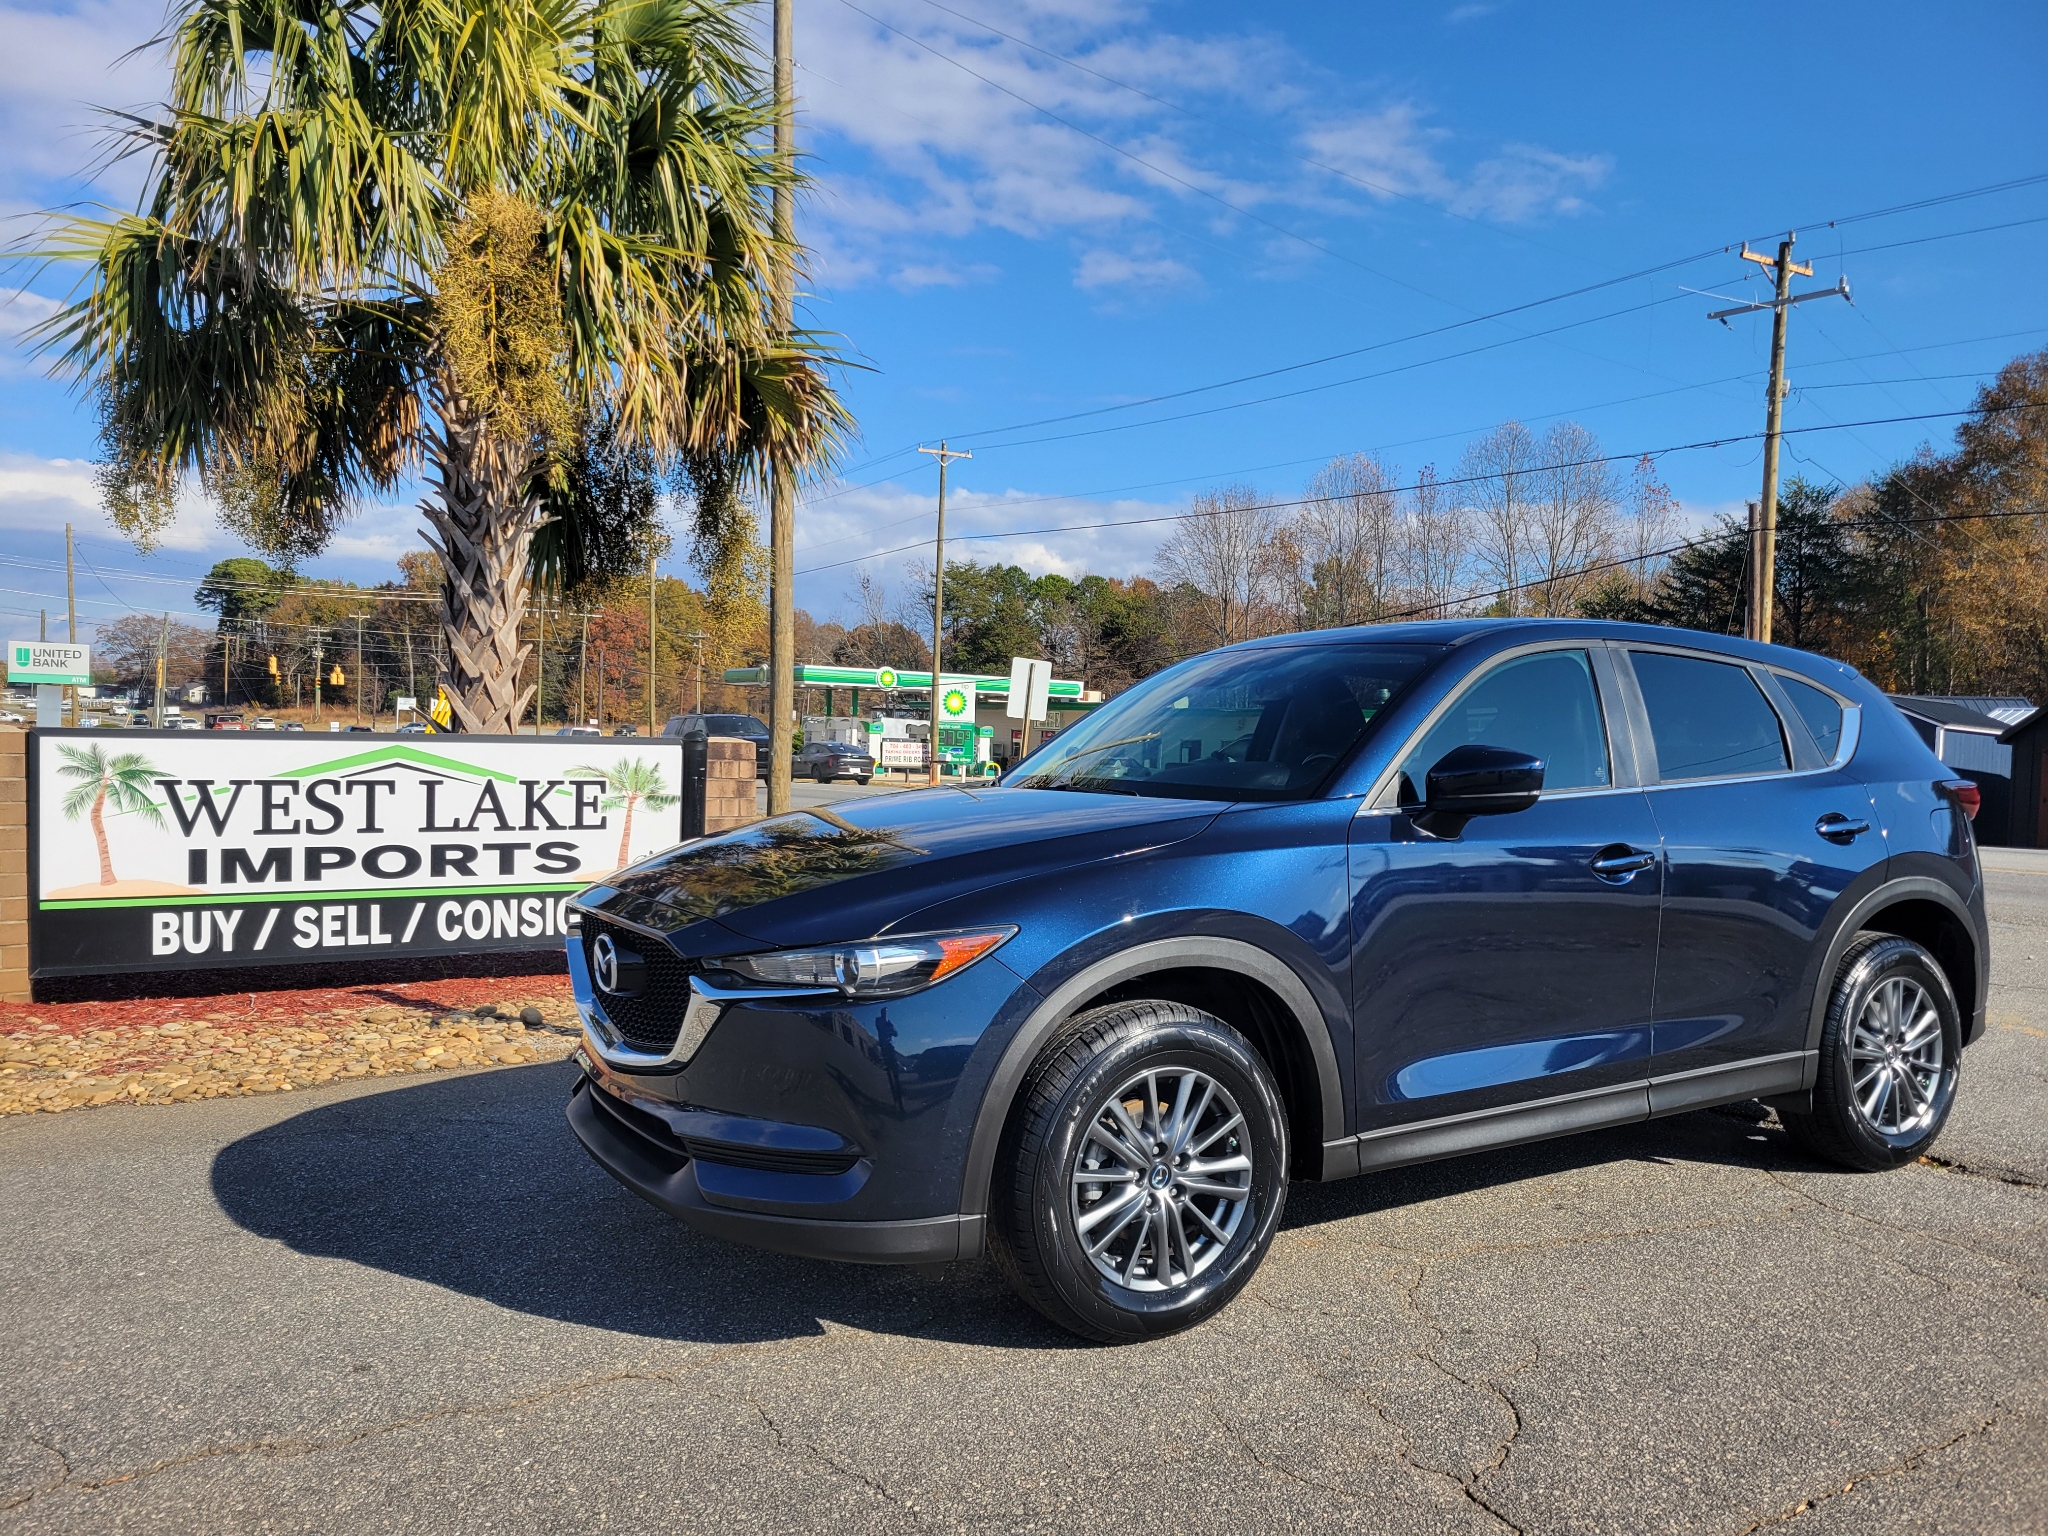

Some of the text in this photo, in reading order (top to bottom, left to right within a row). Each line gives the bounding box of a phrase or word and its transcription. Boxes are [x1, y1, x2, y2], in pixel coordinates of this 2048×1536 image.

[33, 648, 82, 659] UNITED
[33, 658, 68, 668] BANK
[154, 779, 607, 837] WEST LAKE
[188, 841, 582, 885] IMPORTS
[152, 909, 244, 955] BUY
[253, 908, 281, 950] /
[293, 904, 392, 949] SELL
[401, 902, 426, 943] /
